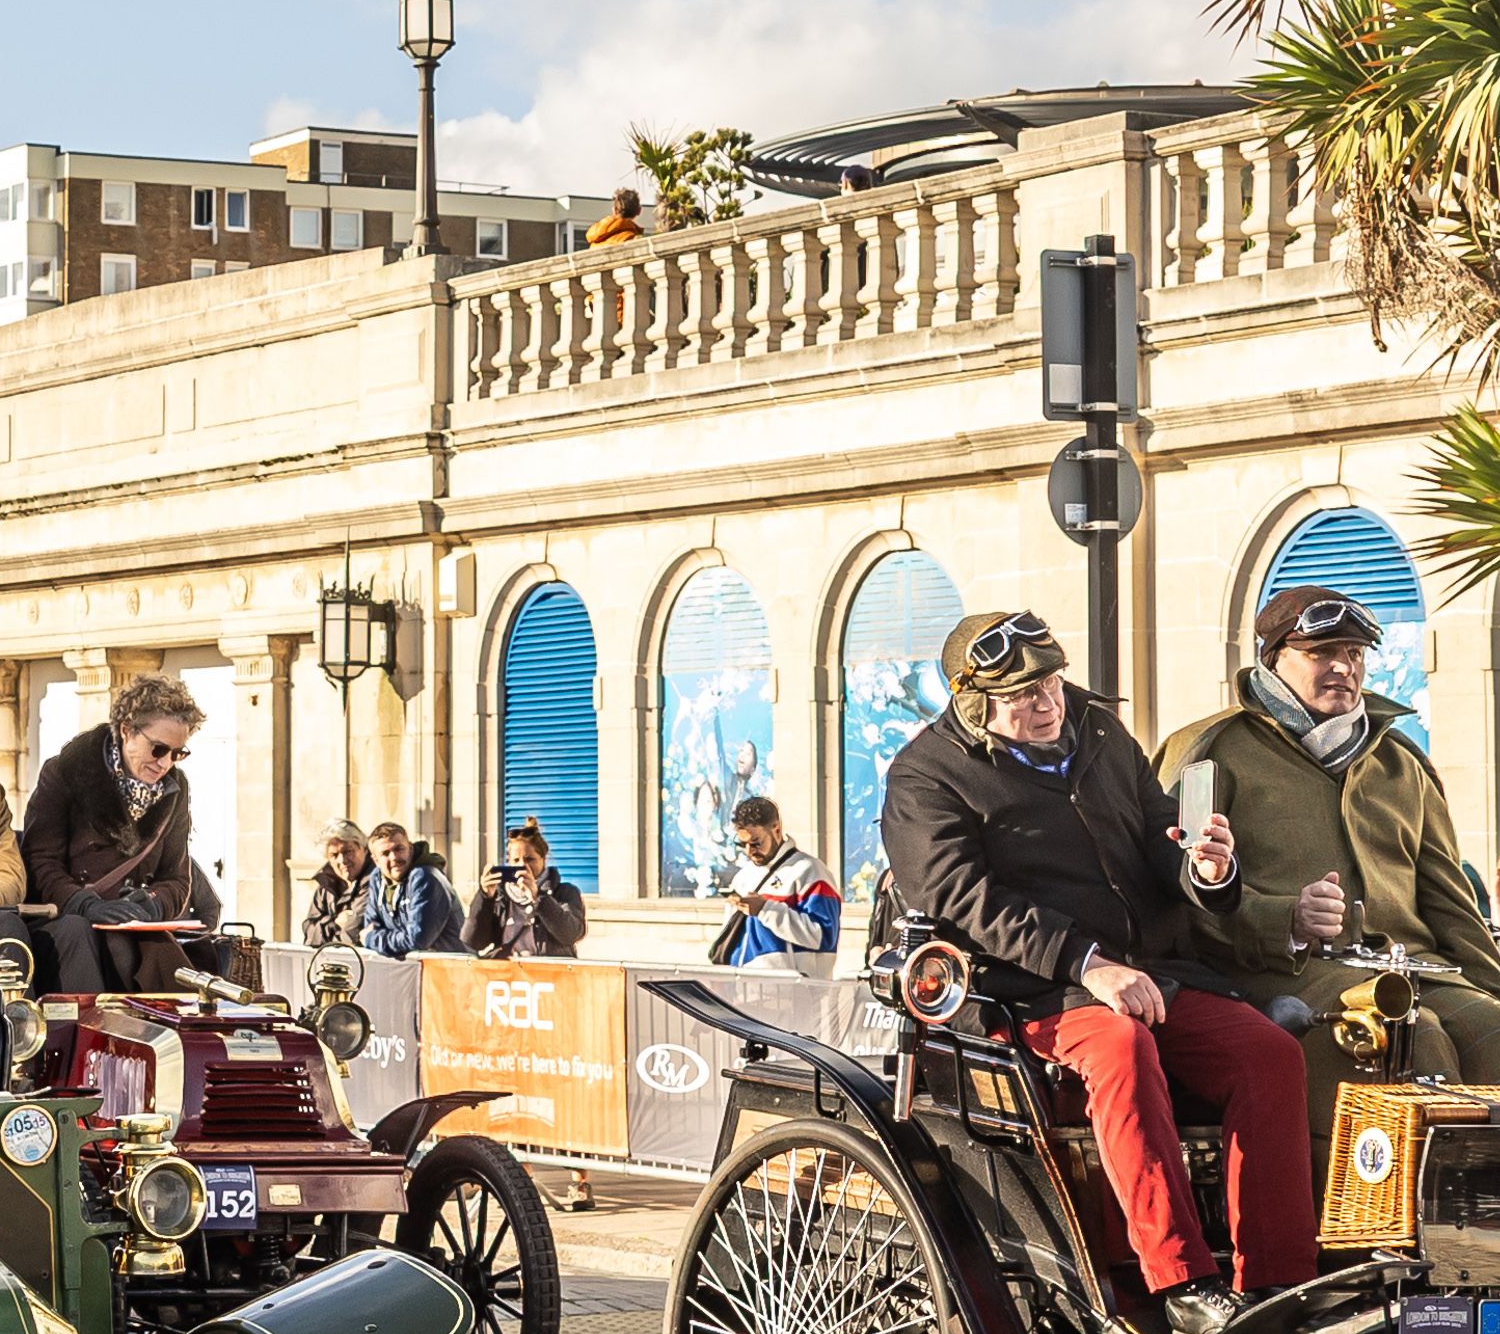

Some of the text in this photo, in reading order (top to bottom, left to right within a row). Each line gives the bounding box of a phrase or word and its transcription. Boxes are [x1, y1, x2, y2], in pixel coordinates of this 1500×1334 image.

[452, 1053, 464, 1068] or
[532, 1053, 557, 1075] here
[558, 1057, 569, 1076] to
[571, 1055, 587, 1078] fix
[586, 1063, 613, 1084] you
[207, 1190, 255, 1218] 152
